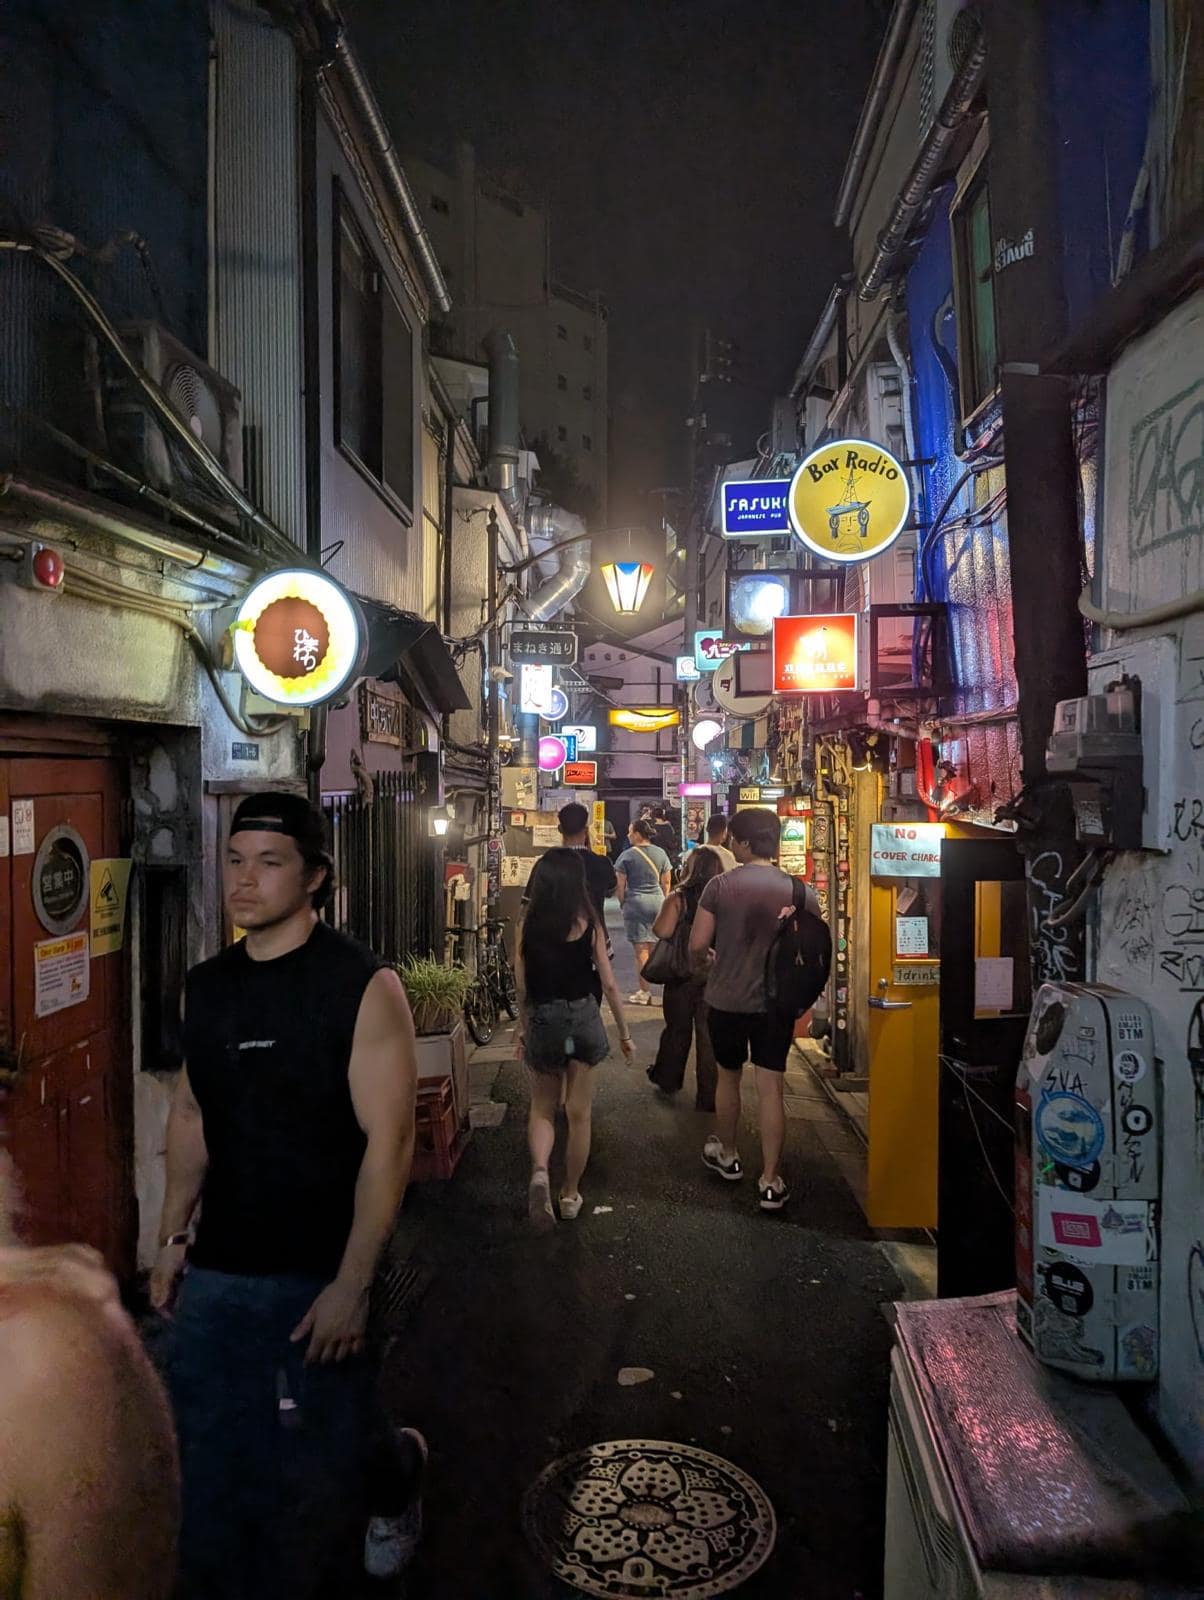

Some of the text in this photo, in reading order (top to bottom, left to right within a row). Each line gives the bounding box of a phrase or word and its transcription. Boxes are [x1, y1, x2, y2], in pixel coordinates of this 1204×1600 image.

[806, 450, 898, 483] Bar Radio
[293, 629, 320, 671] ひまわり
[513, 641, 573, 655] まねき通り
[895, 828, 917, 840] NO
[873, 851, 907, 861] COVER
[1119, 1027, 1144, 1040] BTM
